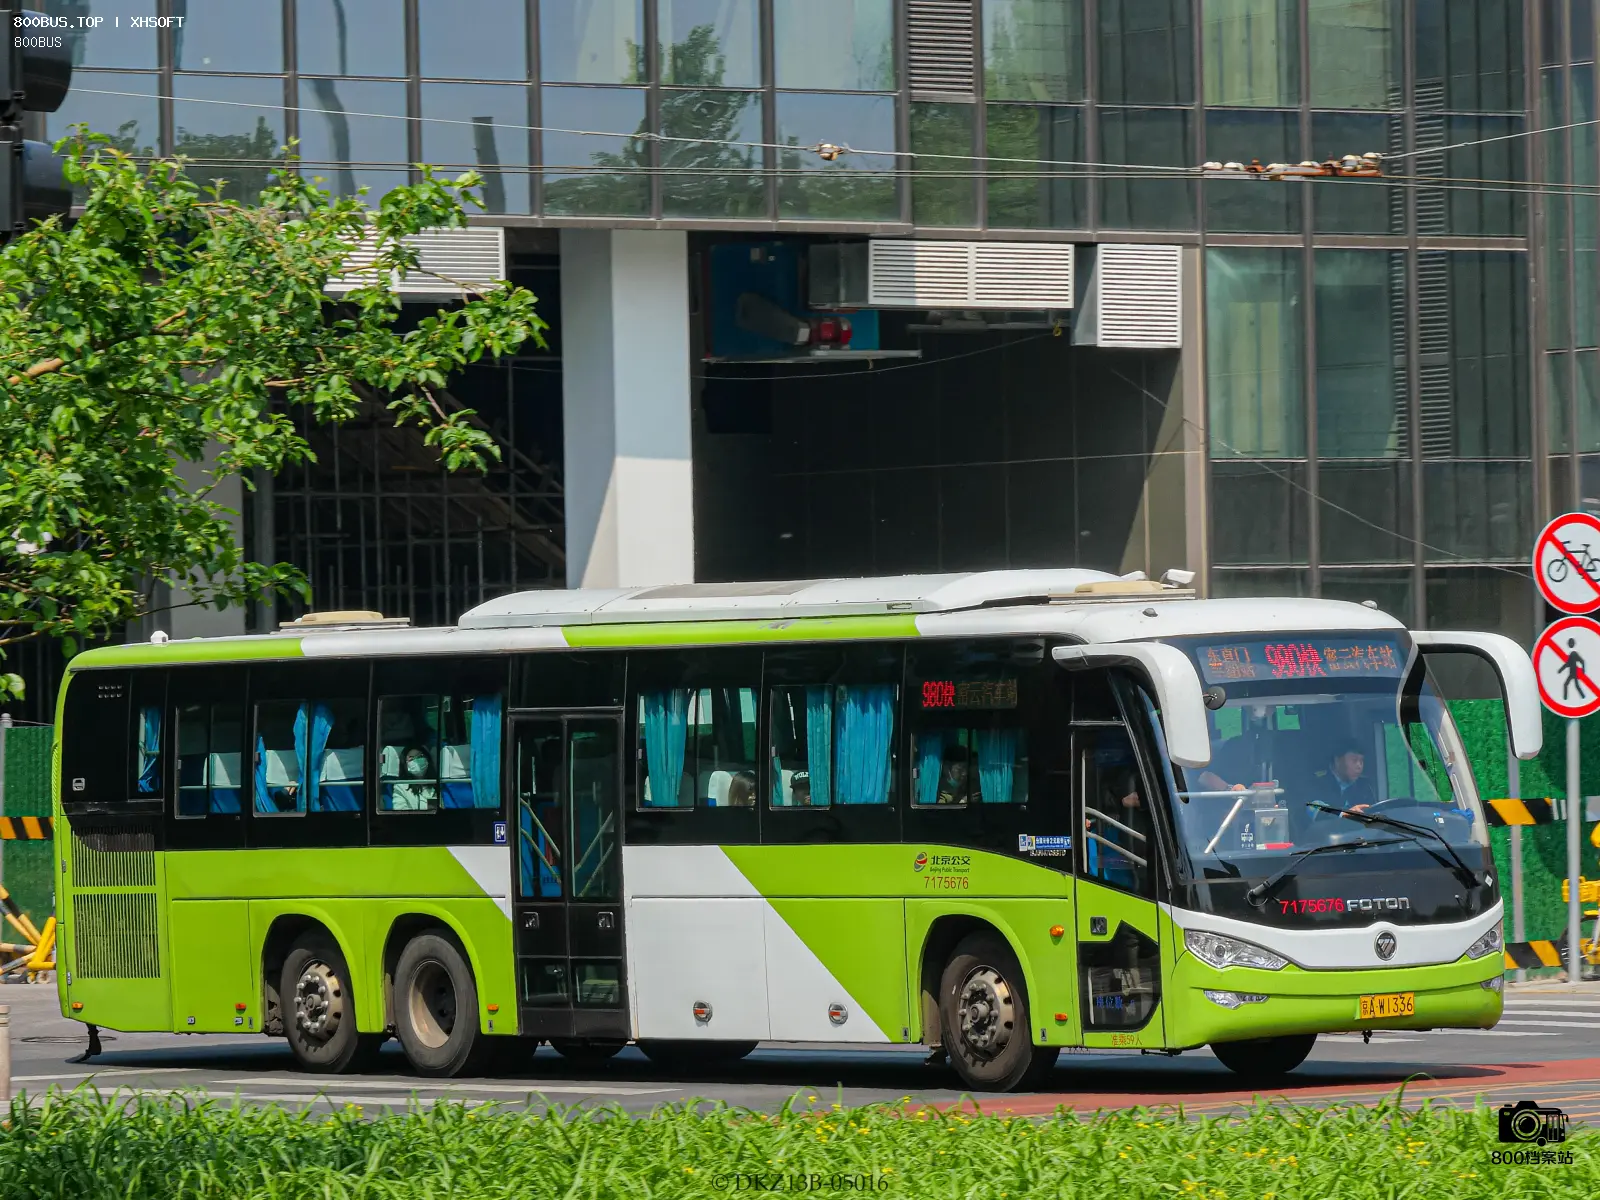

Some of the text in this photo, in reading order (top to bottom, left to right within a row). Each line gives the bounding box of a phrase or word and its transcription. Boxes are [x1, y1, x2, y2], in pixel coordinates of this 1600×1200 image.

[922, 680, 955, 707] 980快
[931, 855, 971, 866] 北京公交
[924, 876, 969, 890] 7175676
[1280, 898, 1345, 914] 7175676
[1347, 897, 1410, 912] FOTON
